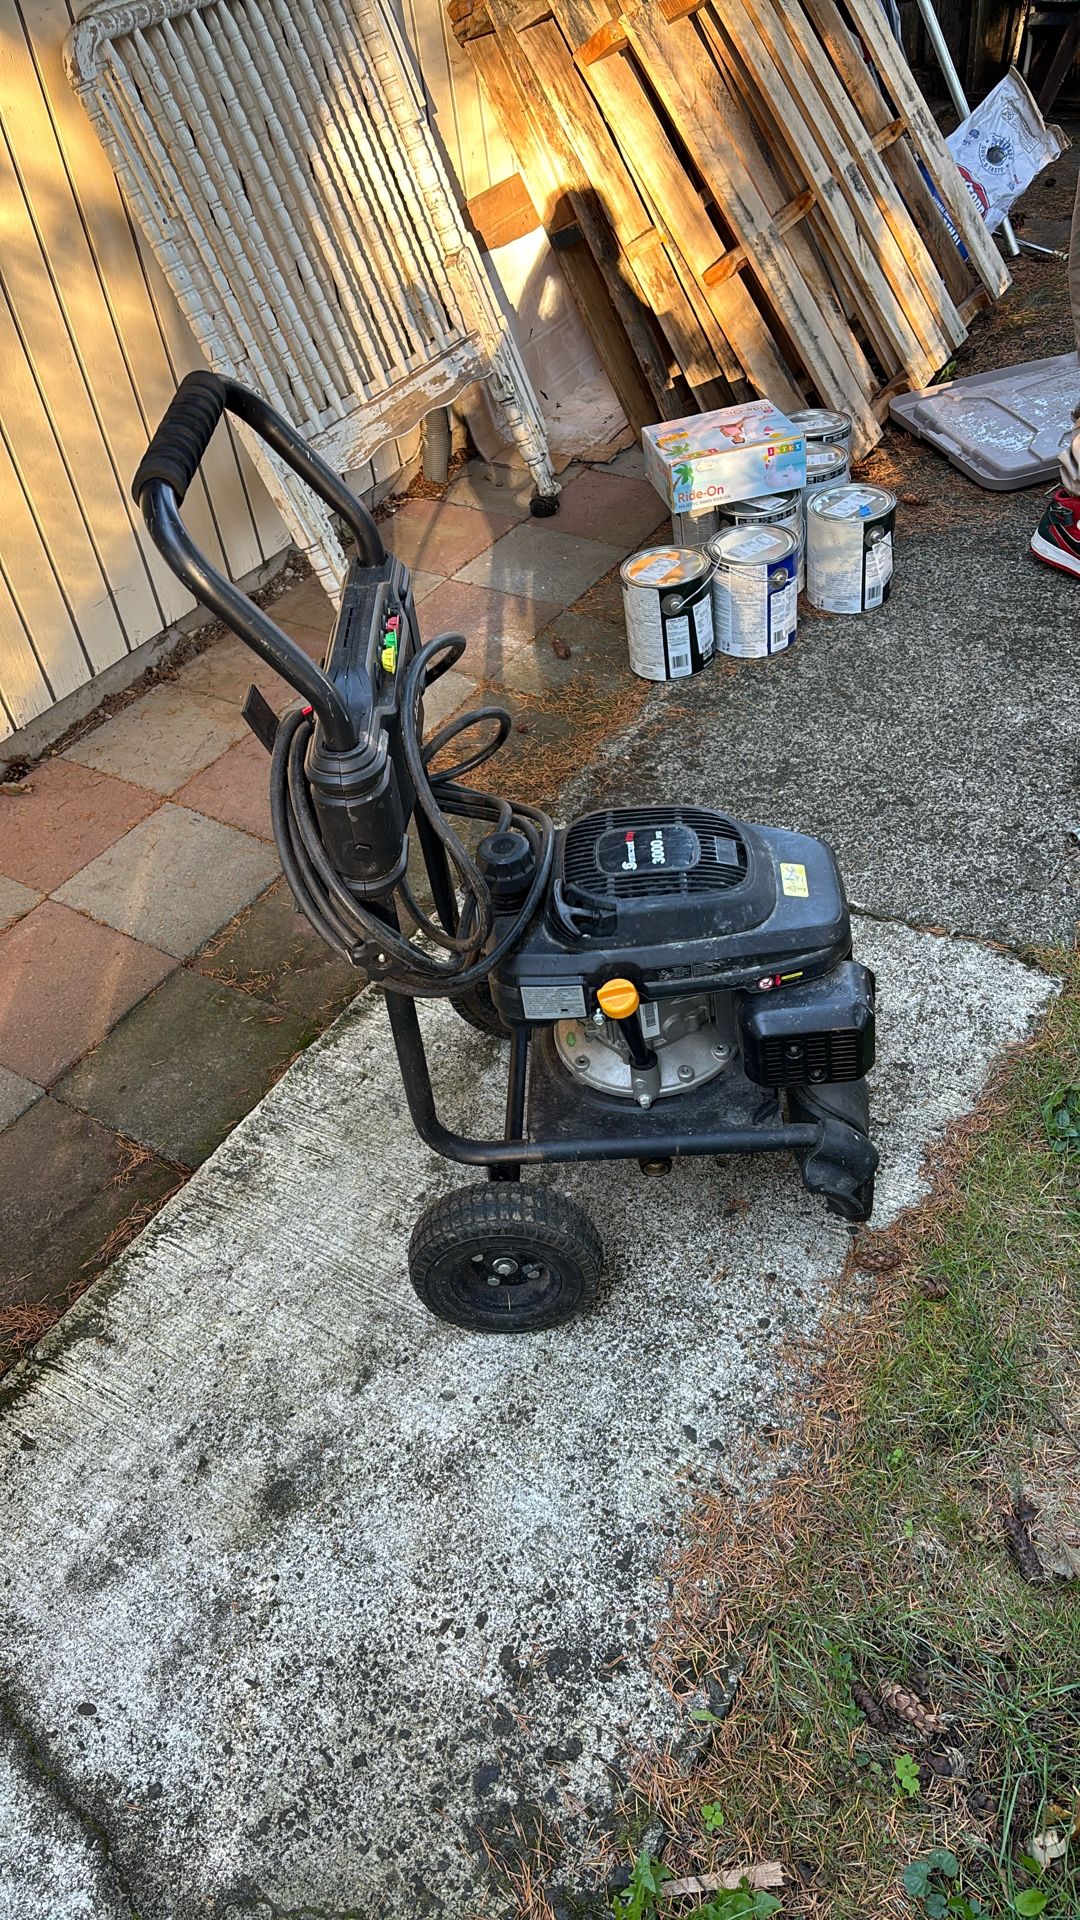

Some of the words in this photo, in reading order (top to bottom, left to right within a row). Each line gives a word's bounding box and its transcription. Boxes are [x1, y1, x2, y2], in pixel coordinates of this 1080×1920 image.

[768, 442, 801, 456] INTEX
[677, 485, 724, 503] Ride-On
[649, 839, 666, 865] 3000
